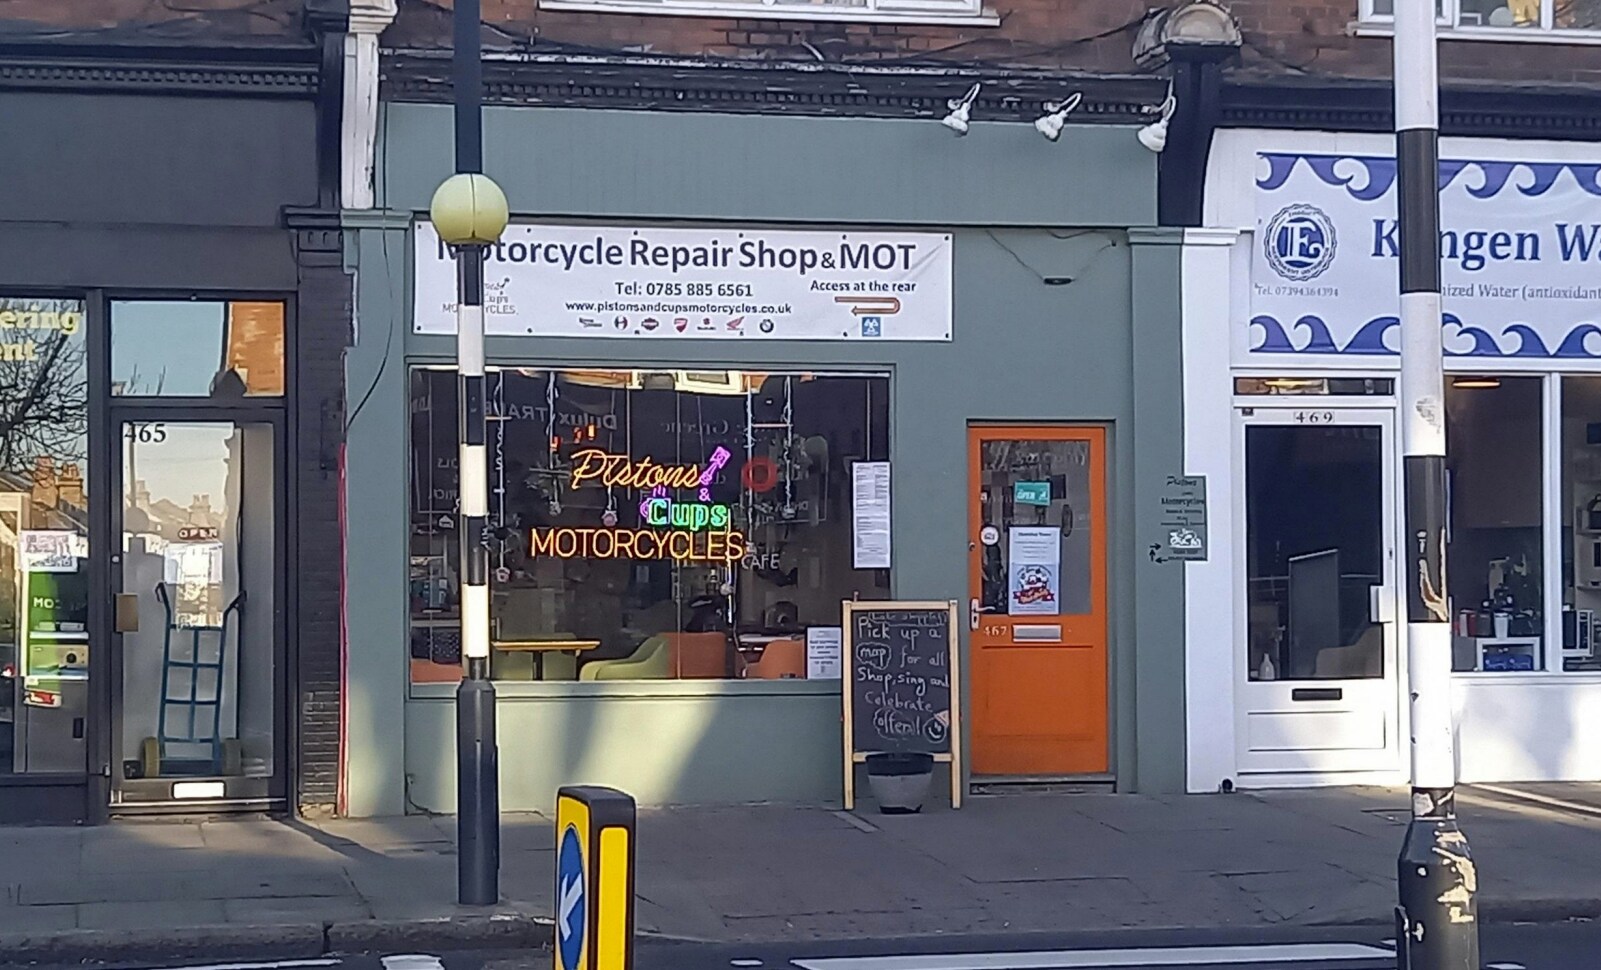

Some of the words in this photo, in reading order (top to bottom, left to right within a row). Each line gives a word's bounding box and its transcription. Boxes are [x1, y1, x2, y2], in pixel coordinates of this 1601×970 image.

[1371, 218, 1541, 271] Kngen
[630, 239, 734, 273] Repair
[738, 240, 818, 275] Shop
[821, 252, 836, 269] &
[840, 243, 916, 270] MOT
[615, 282, 642, 296] Tel:
[646, 282, 682, 296] 0785
[686, 283, 713, 297] 885
[717, 284, 752, 297] 6561
[810, 280, 850, 292] Access
[854, 281, 866, 292] at
[869, 281, 889, 292] the
[892, 282, 916, 293] rear
[1478, 284, 1520, 299] Water
[565, 301, 792, 315] www.pistonsandcupsmotorcycles.co.uk
[1295, 411, 1333, 424] 469
[124, 423, 167, 443] 465
[571, 449, 703, 490] Pistons
[699, 487, 712, 501] &
[648, 498, 729, 531] Cups
[179, 526, 220, 538] OPEN
[530, 529, 745, 561] MOTORCYCLES
[741, 553, 780, 570] CAFE
[858, 616, 891, 639] Pick
[900, 629, 920, 651] up
[928, 628, 942, 639] a
[983, 625, 1008, 637] 467
[860, 647, 886, 667] map
[900, 645, 921, 668] for
[928, 651, 945, 666] all
[930, 674, 949, 688] and
[864, 691, 933, 713] Celebrate
